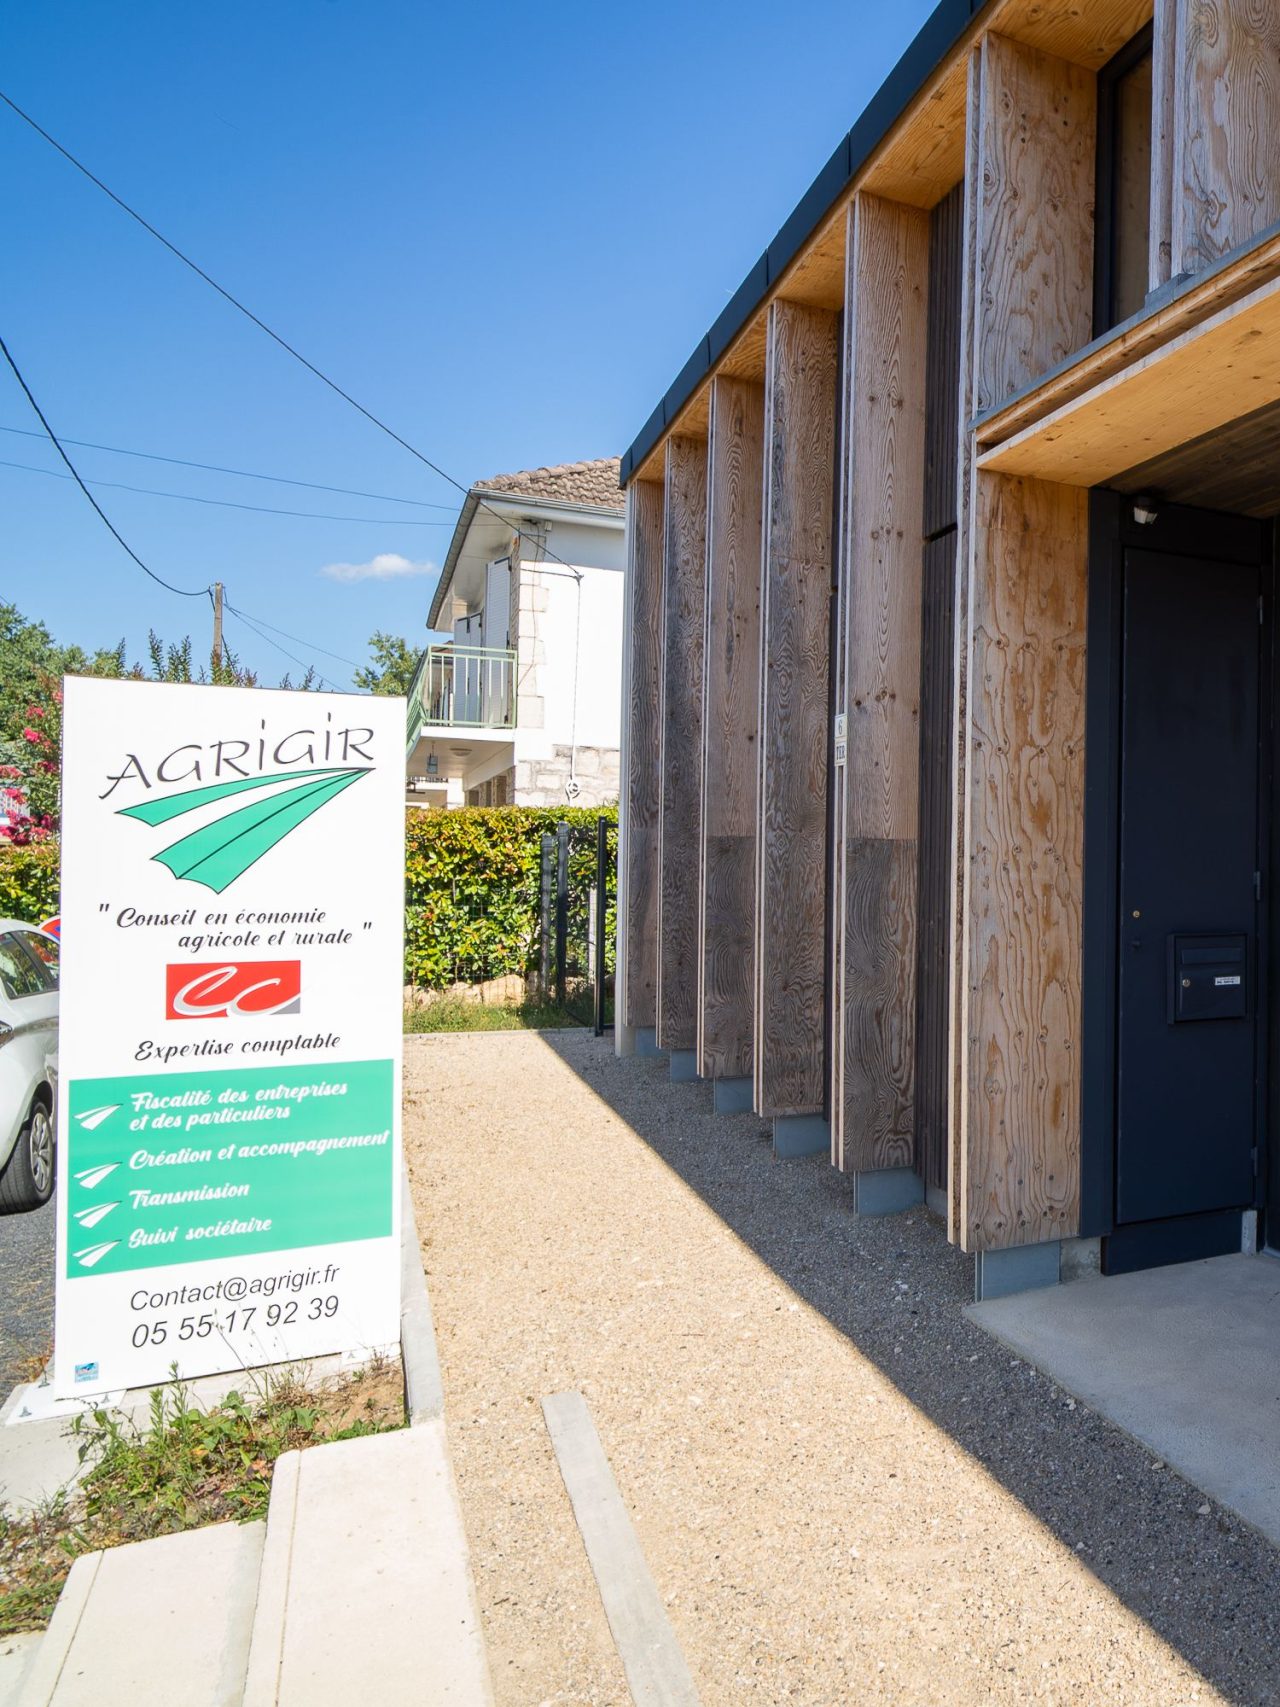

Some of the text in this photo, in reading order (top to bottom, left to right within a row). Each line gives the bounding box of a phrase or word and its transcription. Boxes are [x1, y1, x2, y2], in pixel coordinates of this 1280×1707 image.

[116, 907, 196, 928] Conseil
[205, 912, 228, 925] en
[235, 909, 326, 925] économie
[178, 930, 261, 953] agricole
[268, 930, 284, 946] et
[293, 930, 353, 946] rurale
[135, 1033, 341, 1063] Expertise comptable
[129, 1081, 348, 1113] Fiscalité des entreprises
[130, 1105, 290, 1131] et des particuliers
[129, 1130, 391, 1170] Création et accompagnement
[129, 1182, 250, 1209] Transmission
[128, 1217, 272, 1249] Suivi sociétaire
[130, 1264, 341, 1312] Contact@agrigir.fr
[132, 1295, 339, 1348] 05 55 17 92 39
